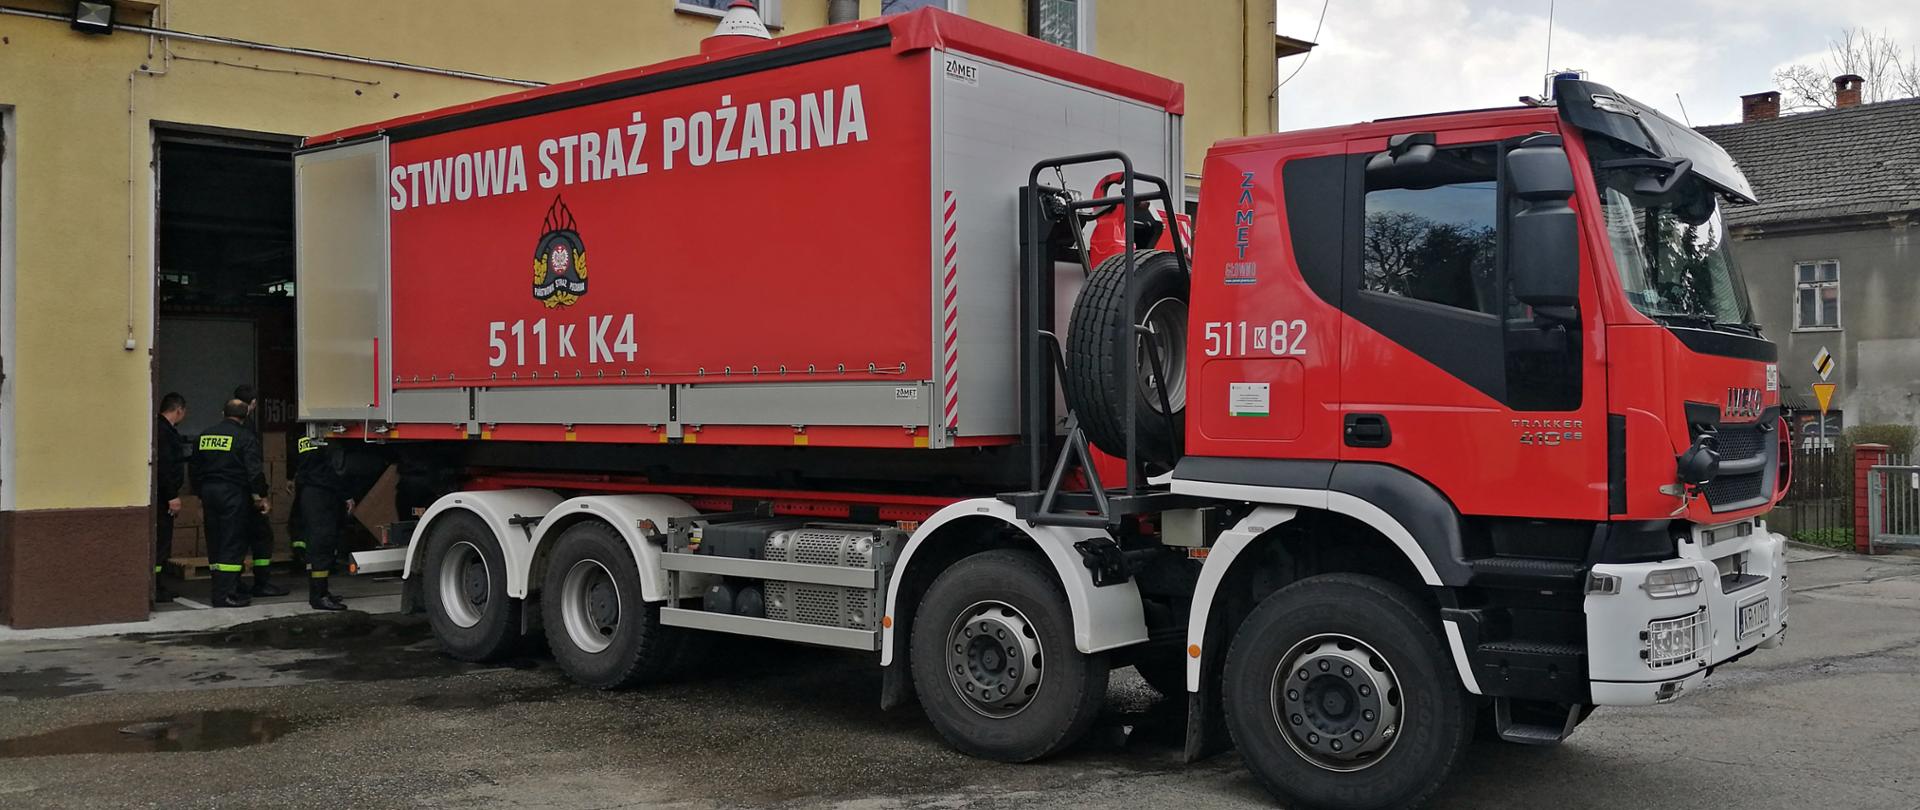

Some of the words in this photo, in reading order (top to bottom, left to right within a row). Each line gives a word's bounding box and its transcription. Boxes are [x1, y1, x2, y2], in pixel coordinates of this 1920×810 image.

[946, 60, 977, 79] ZAMET
[390, 144, 528, 211] STWOWA
[538, 111, 649, 189] STRAŻ
[663, 84, 869, 170] POŻARNA
[1235, 171, 1255, 259] ZAMET
[489, 318, 547, 367] 511
[559, 324, 577, 358] K
[588, 313, 638, 364] K4
[1205, 321, 1247, 356] 511
[1270, 319, 1307, 355] 82
[1511, 419, 1583, 428] TRAKKER
[1520, 431, 1561, 446] 410
